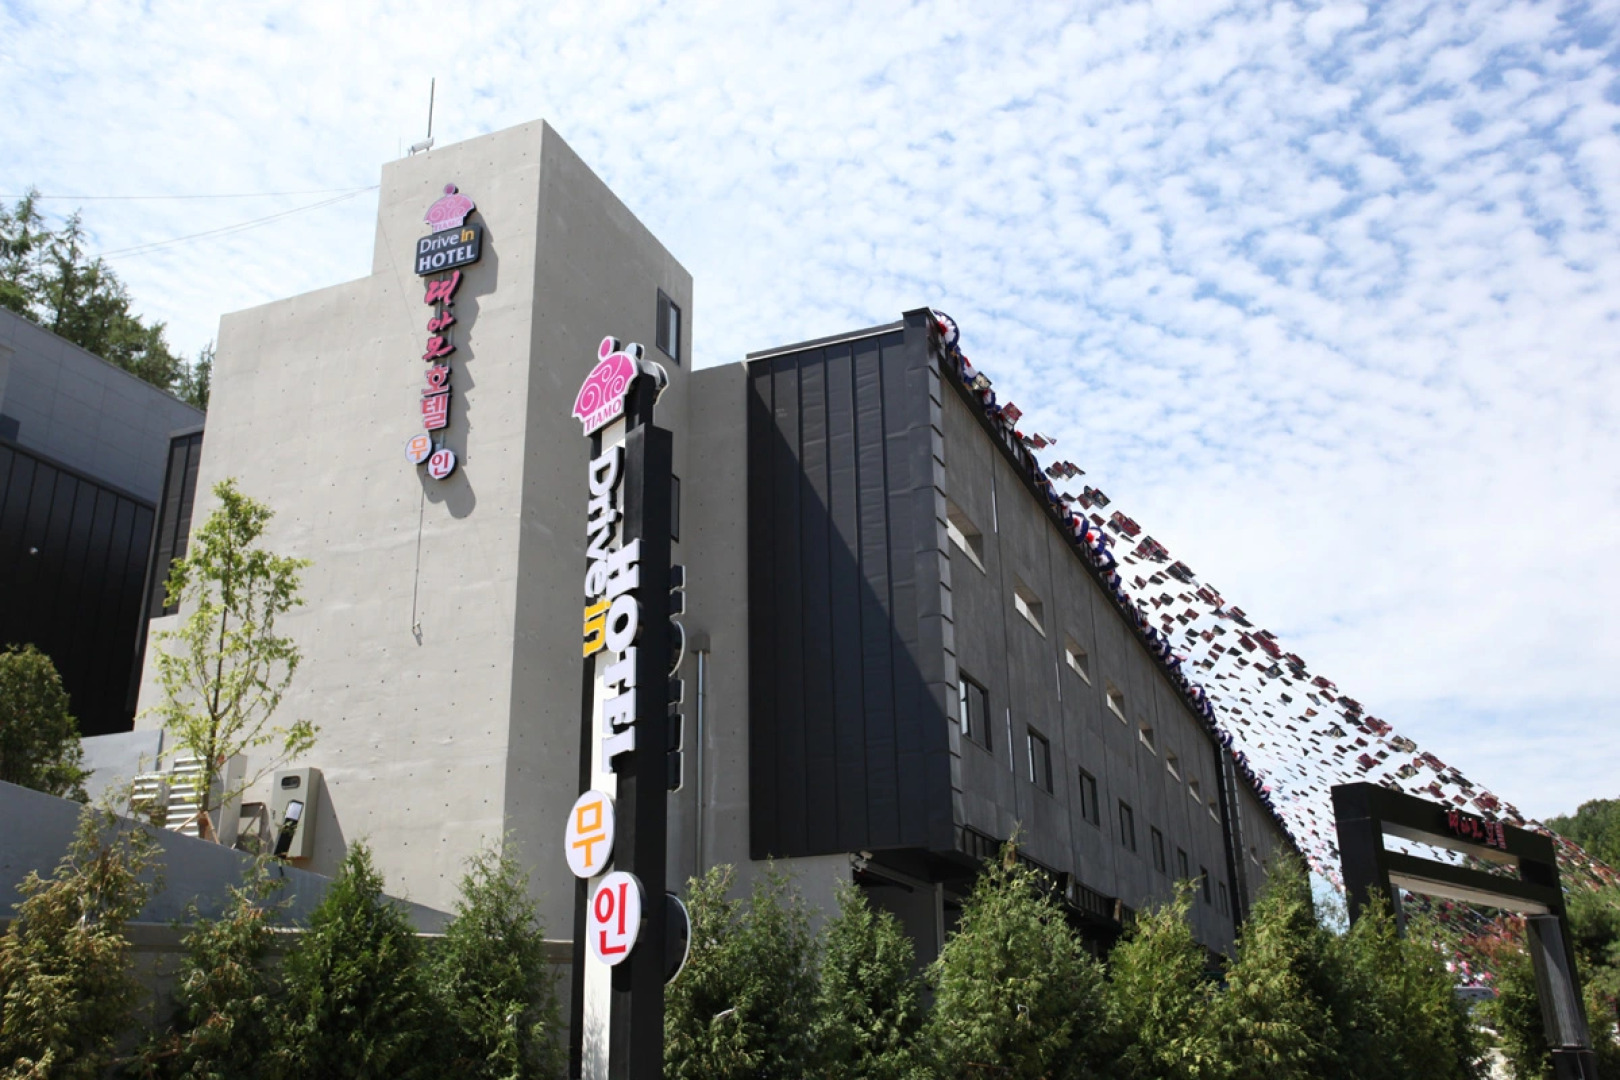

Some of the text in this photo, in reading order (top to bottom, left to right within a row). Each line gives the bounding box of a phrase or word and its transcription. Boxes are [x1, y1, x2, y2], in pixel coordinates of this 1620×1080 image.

[418, 244, 475, 272] HOTEL
[420, 228, 475, 254] Drive in
[420, 364, 450, 430] 호텔
[585, 398, 622, 431] TIAMO
[583, 445, 619, 658] Drive in
[602, 538, 640, 774] HOTEL
